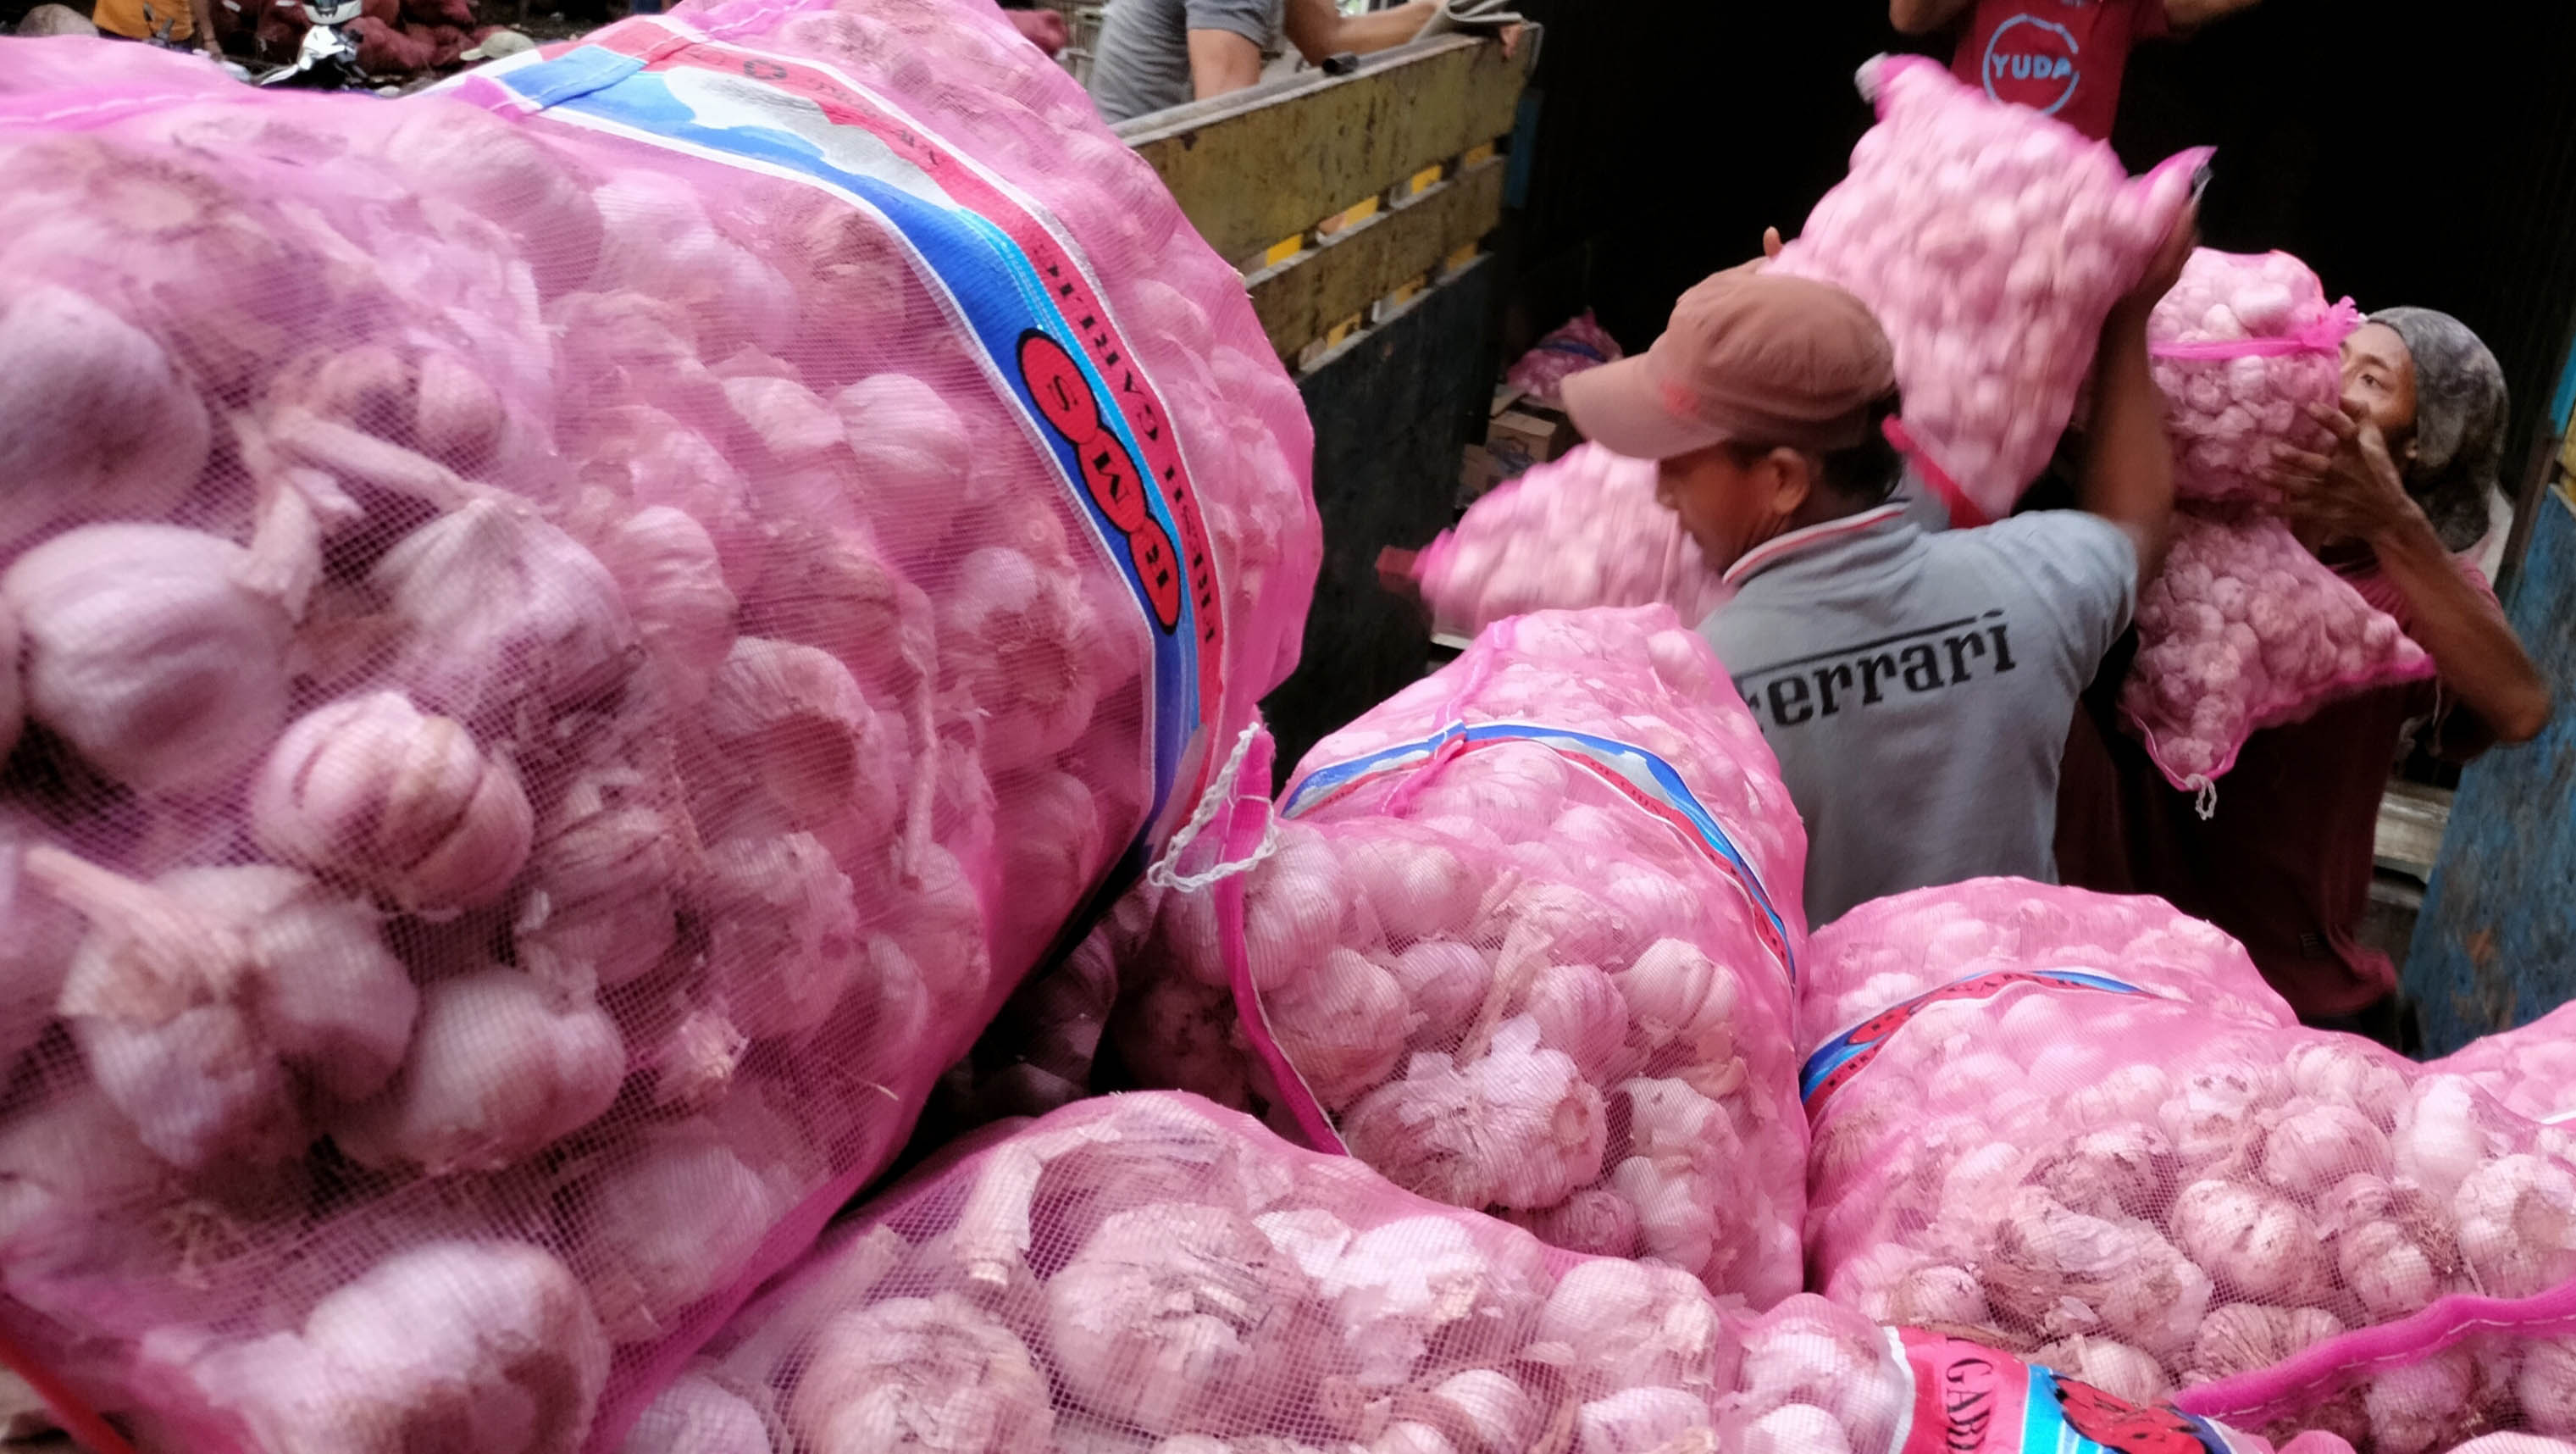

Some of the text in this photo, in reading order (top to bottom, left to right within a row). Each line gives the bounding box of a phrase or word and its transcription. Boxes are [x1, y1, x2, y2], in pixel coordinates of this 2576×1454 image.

[1992, 54, 2072, 79] YUDA
[1033, 244, 1216, 642] FRESH GARLIC
